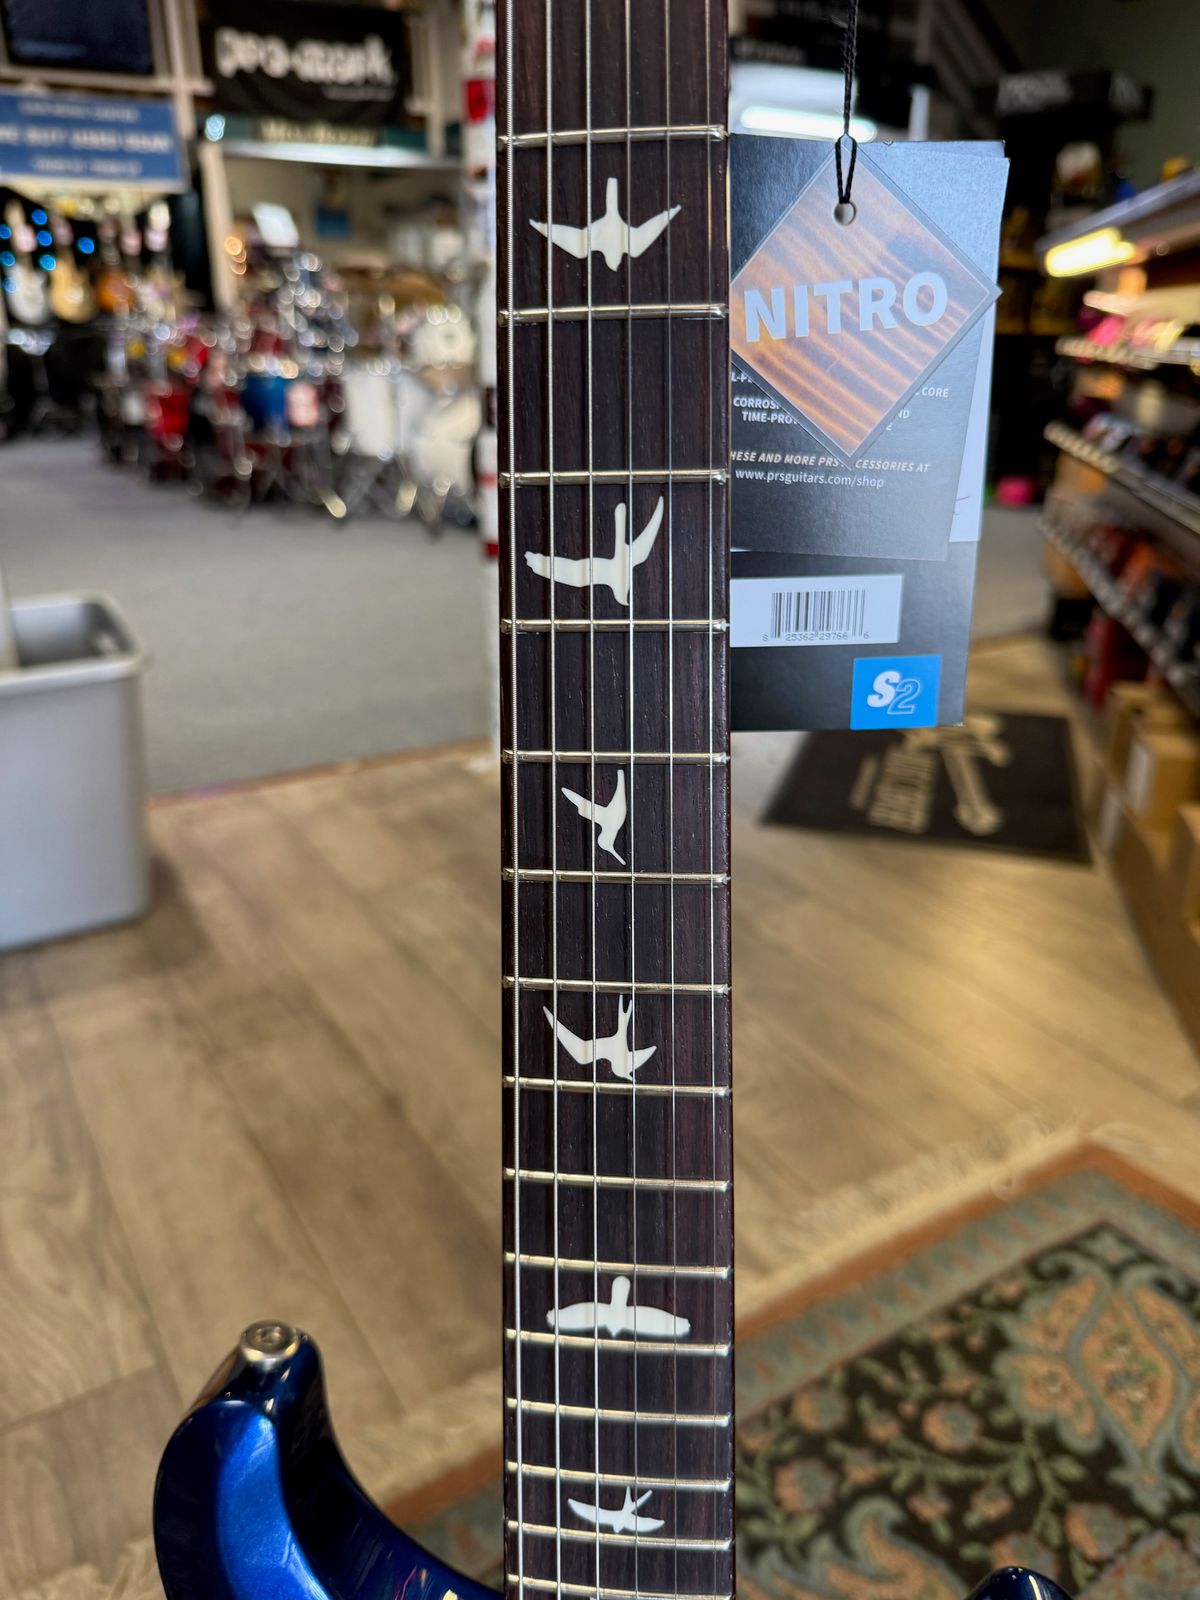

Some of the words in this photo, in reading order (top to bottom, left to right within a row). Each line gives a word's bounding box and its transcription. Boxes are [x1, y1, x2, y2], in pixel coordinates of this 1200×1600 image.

[743, 271, 949, 342] NITRO
[921, 386, 949, 398] CORE
[733, 396, 780, 410] CORROS
[741, 411, 797, 425] TIME-PRO
[758, 452, 782, 464] AND
[783, 454, 816, 466] MORE
[818, 456, 839, 467] PRS
[916, 463, 931, 473] AT
[735, 470, 885, 489] www.prsguitars.com/shop
[867, 670, 921, 715] S2
